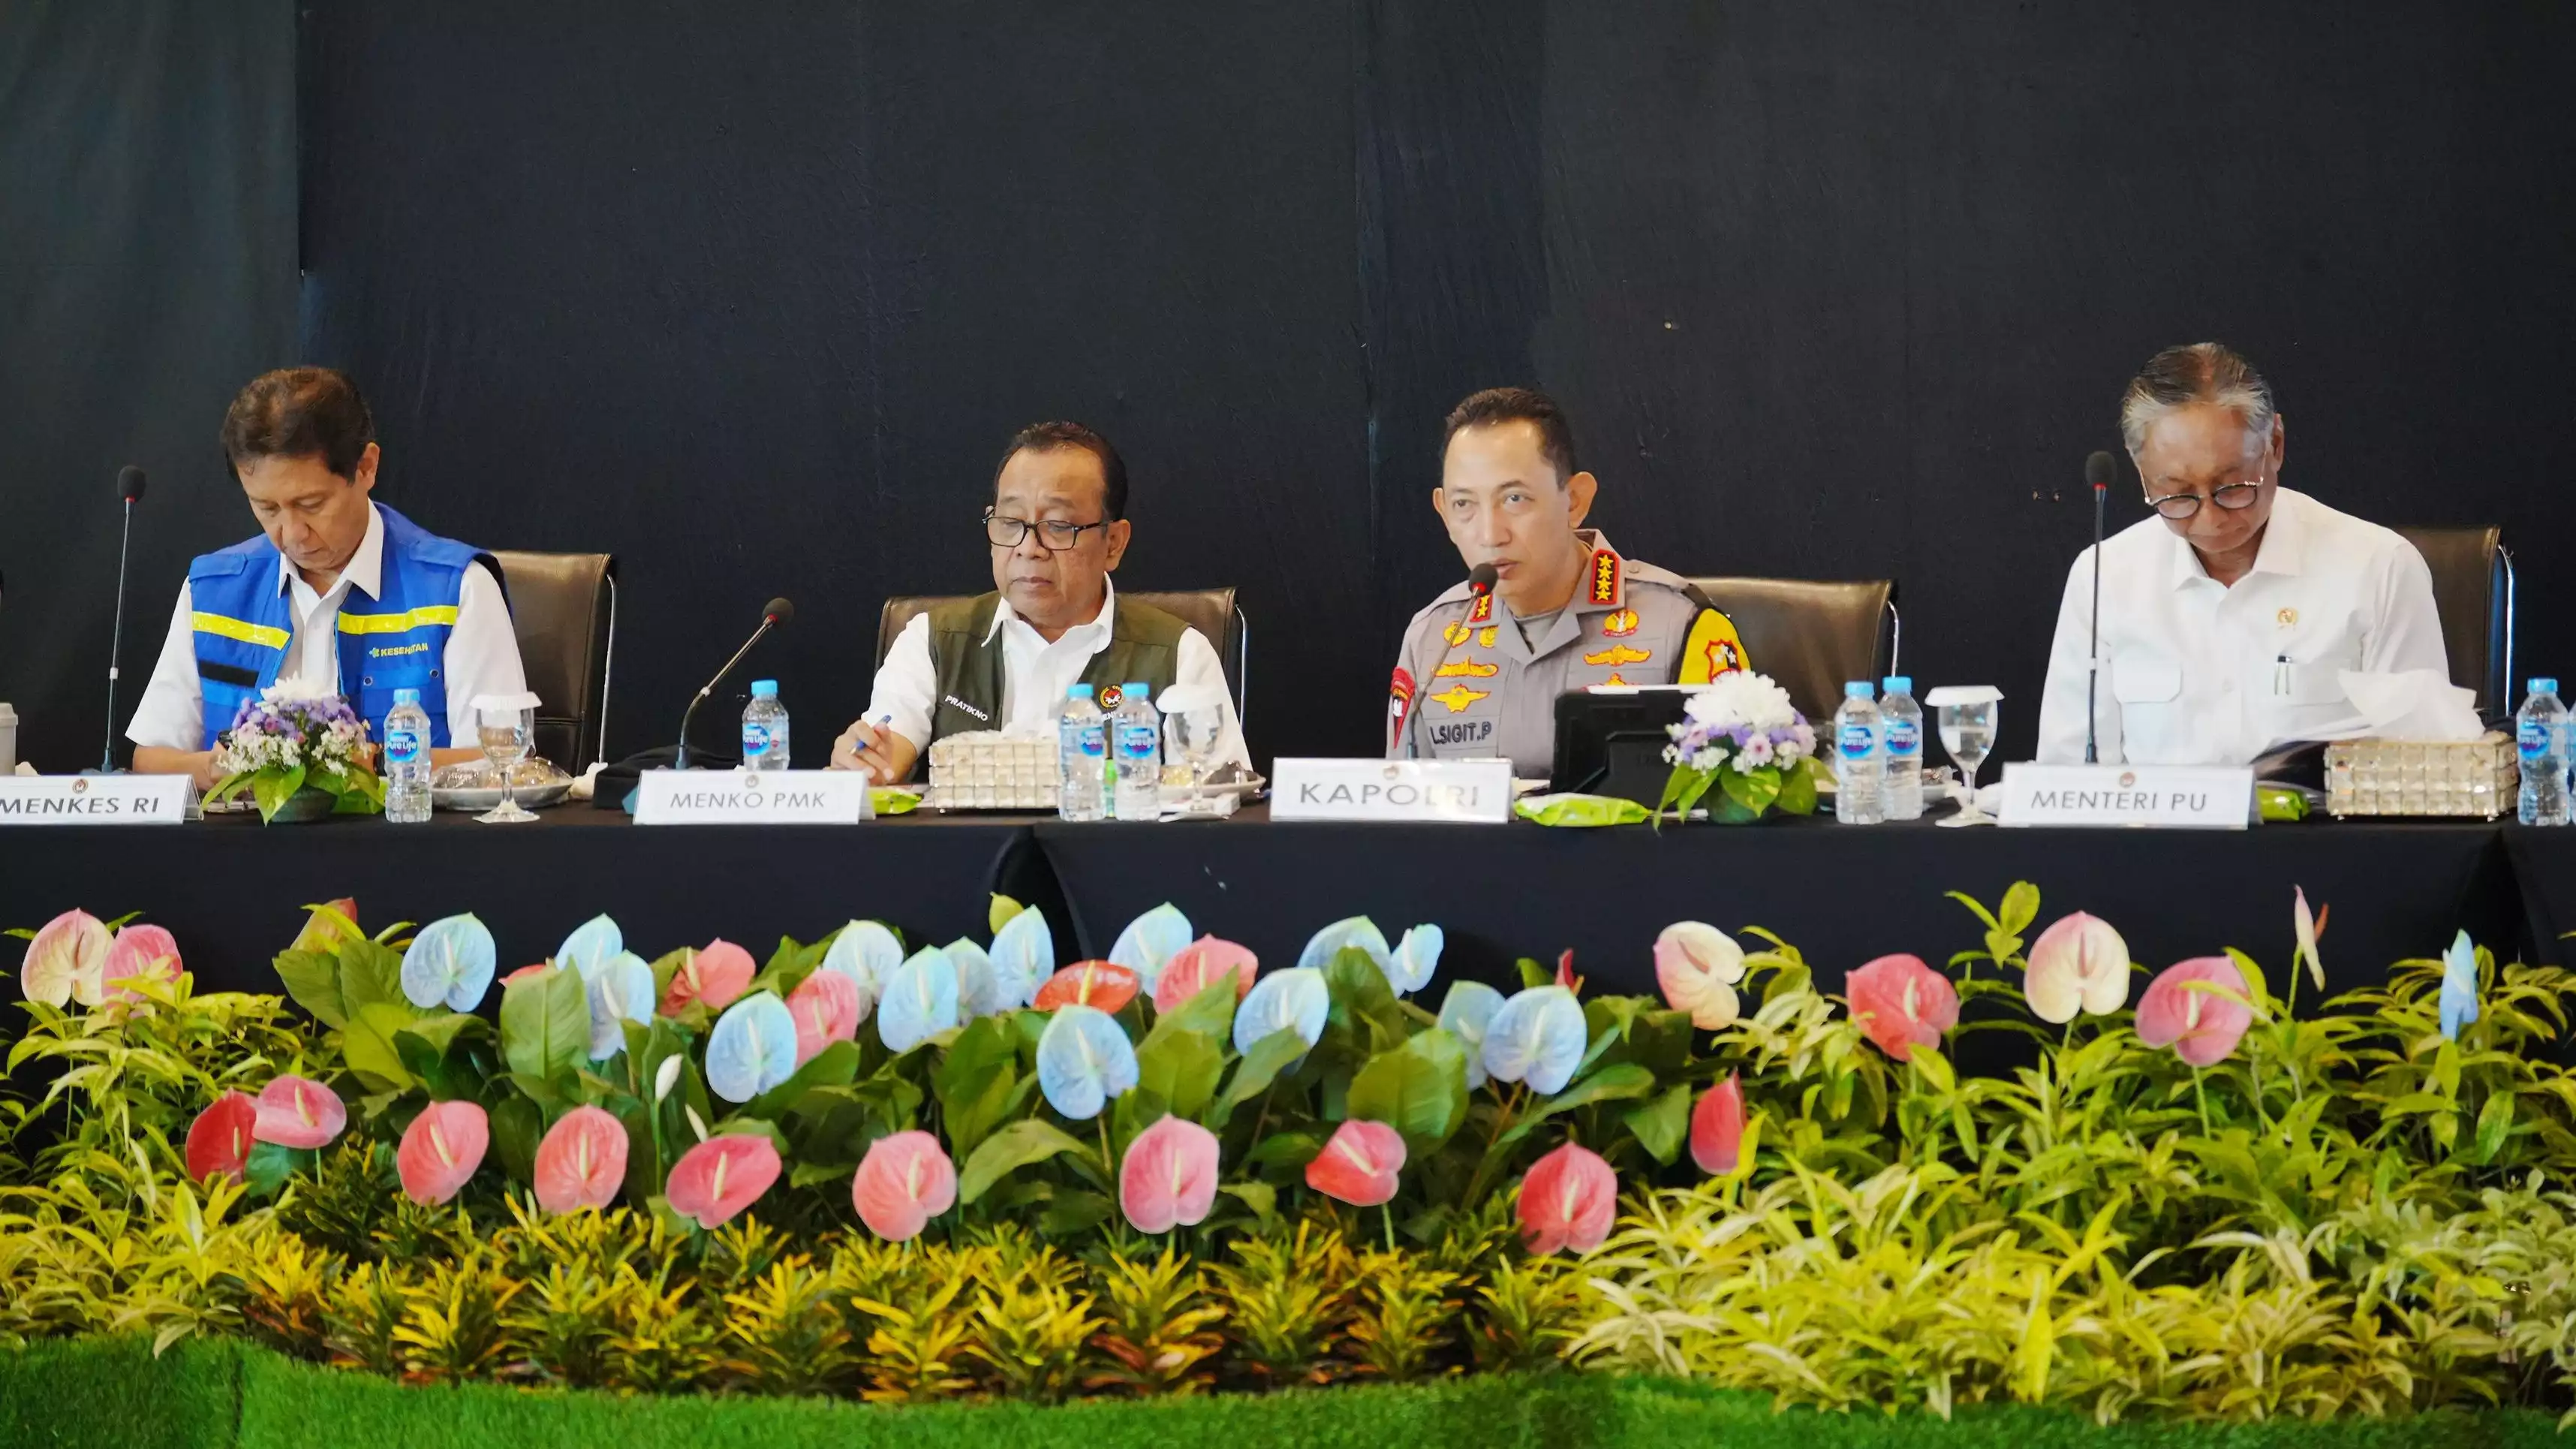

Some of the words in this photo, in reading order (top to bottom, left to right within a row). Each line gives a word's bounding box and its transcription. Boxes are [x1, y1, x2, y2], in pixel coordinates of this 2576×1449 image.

[945, 694, 989, 721] PRATIKNO
[670, 792, 764, 809] MENKO
[773, 792, 826, 809] PMK
[1299, 783, 1479, 806] KAPOLRI
[2030, 791, 2157, 810] MENTERI
[2171, 792, 2207, 812] PU
[0, 797, 119, 815] MENKES
[132, 797, 159, 813] RI
